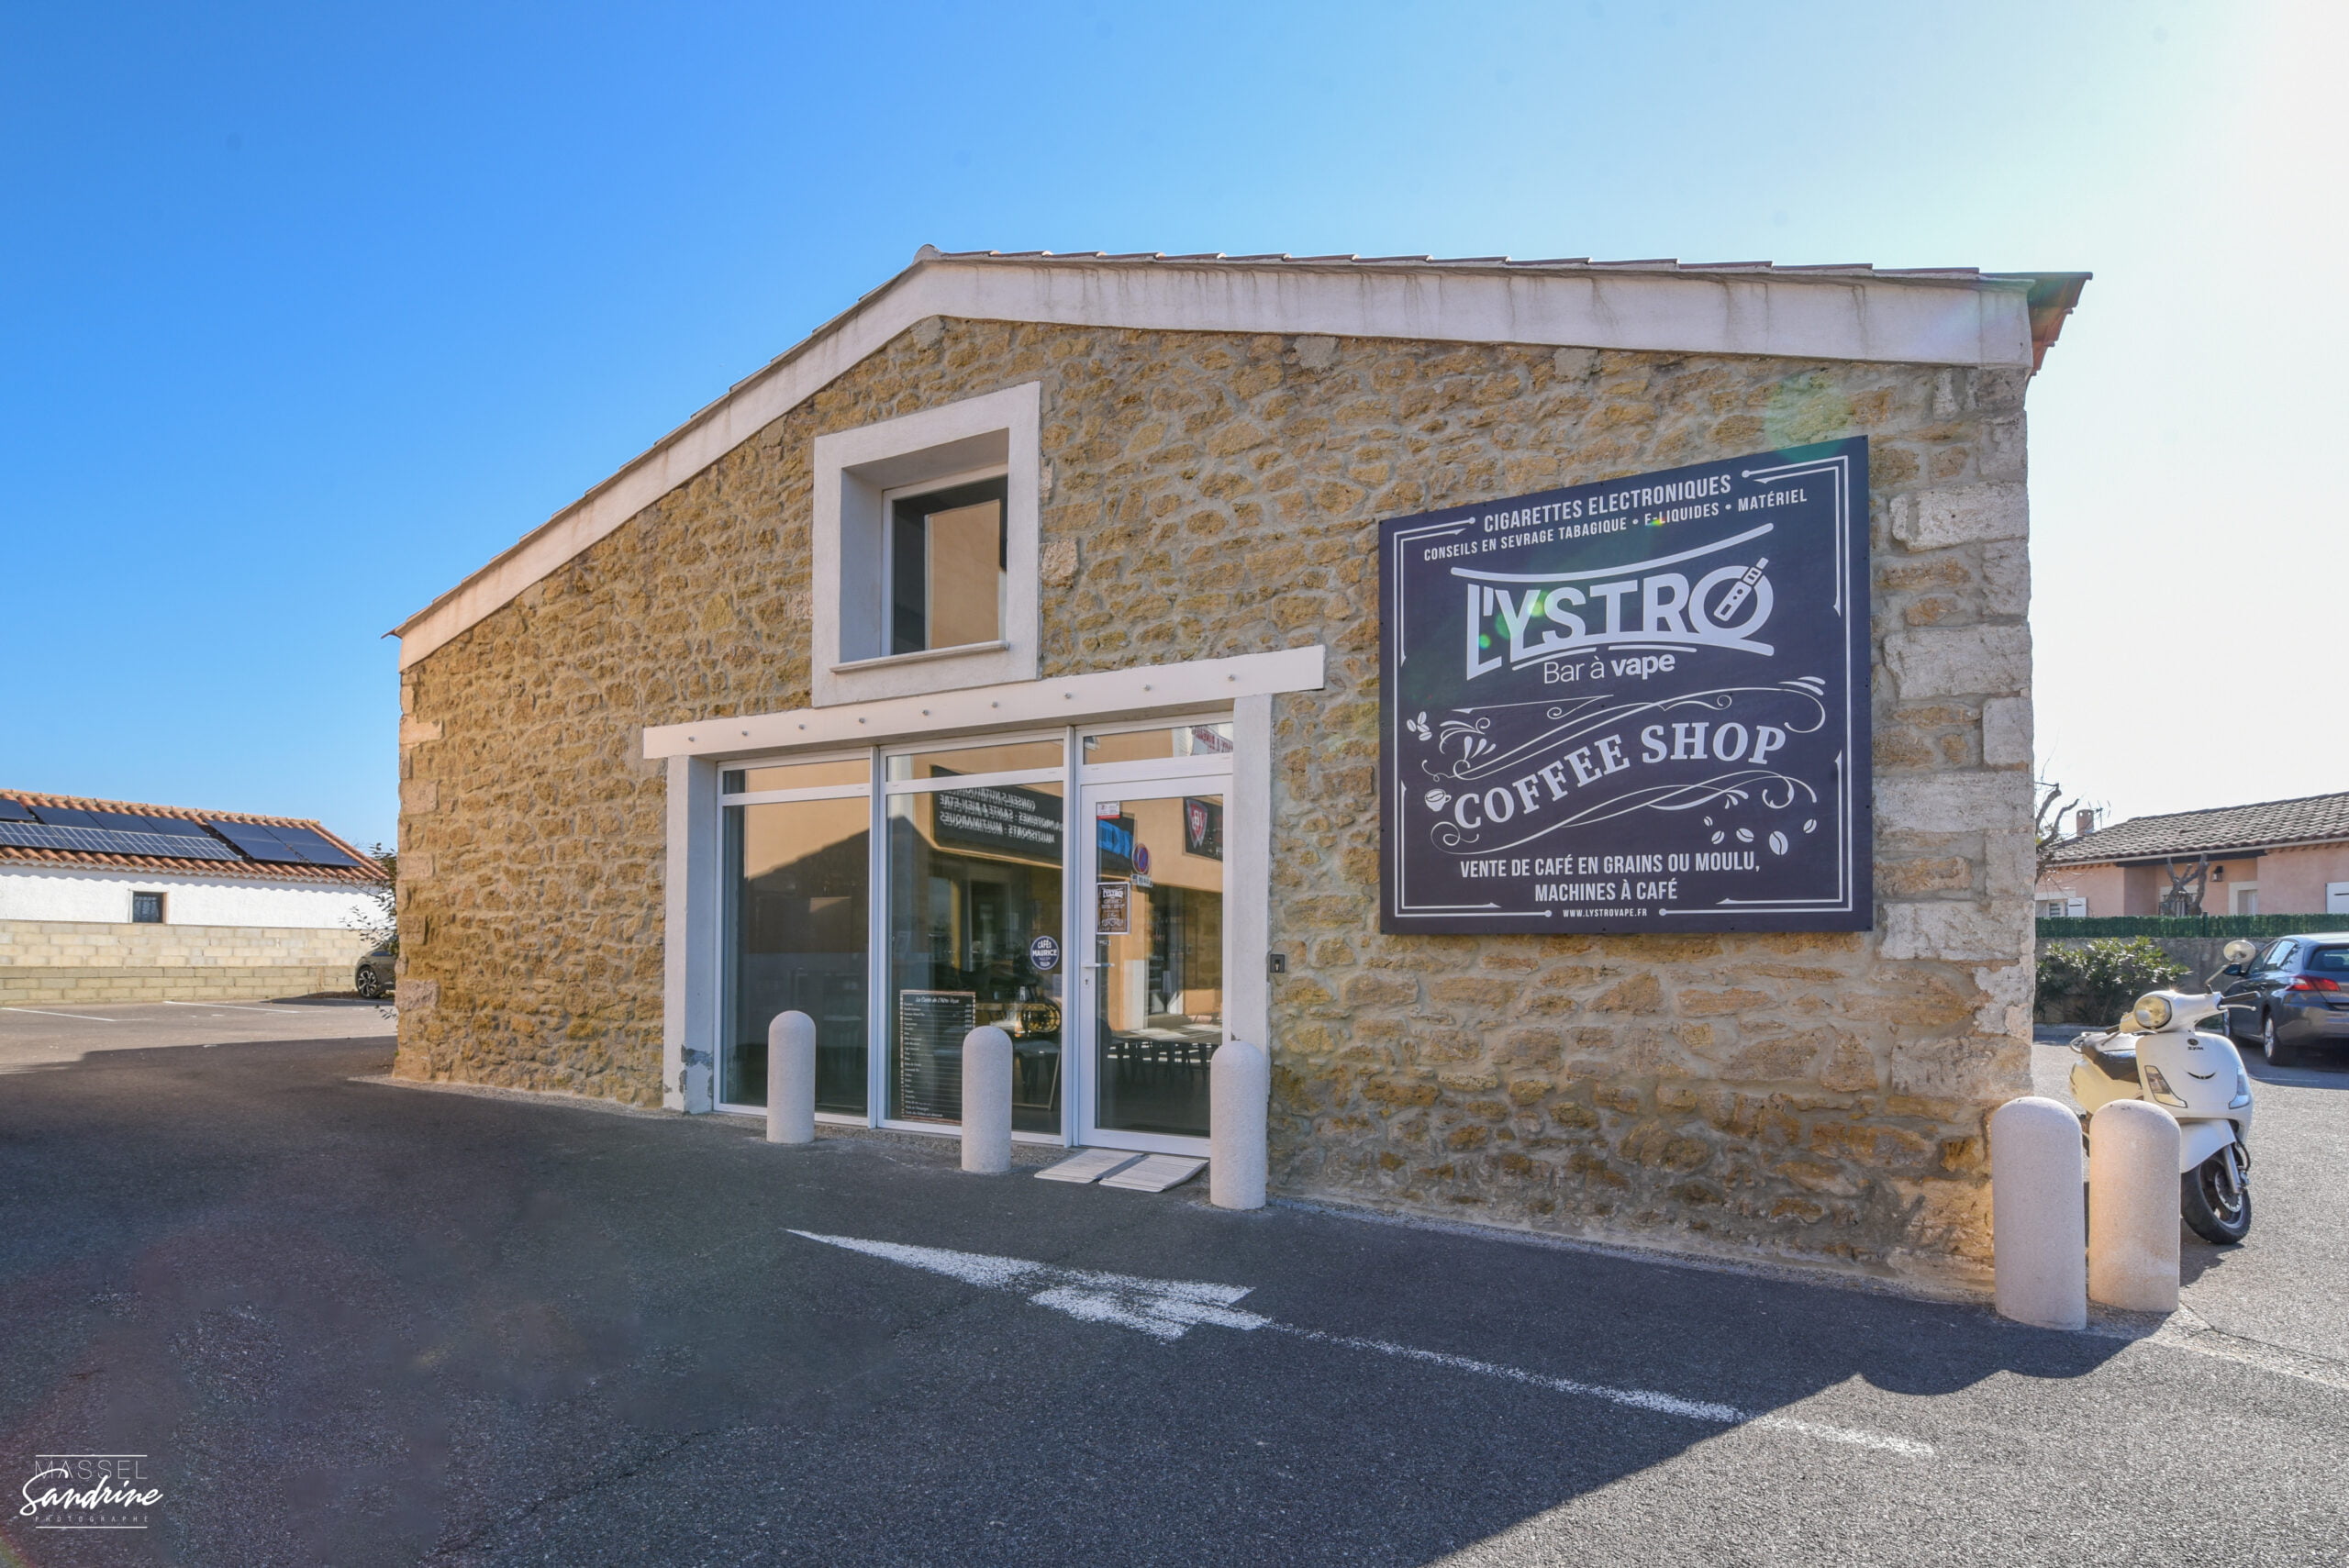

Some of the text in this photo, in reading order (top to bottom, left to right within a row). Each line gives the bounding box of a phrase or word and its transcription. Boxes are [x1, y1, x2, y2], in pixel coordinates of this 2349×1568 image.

[1484, 473, 1731, 533] CIGARETTES ELECTRONIQUES
[1424, 489, 1808, 562] CONSEILS EN SEVRAGE TABAGIQUE E-LIQUIDES MATÉRIEL
[1543, 652, 1675, 684] Bar à vape
[1454, 721, 1786, 829] COFFEE SHOP
[1460, 851, 1761, 878] VENTE DE CAFÉ EN GRAINS OU MOULU,
[1535, 877, 1678, 902] MACHINES À CAFÉ
[1563, 908, 1648, 917] WWW.LYSTROVAPE.FR
[1032, 949, 1058, 957] MAURICE
